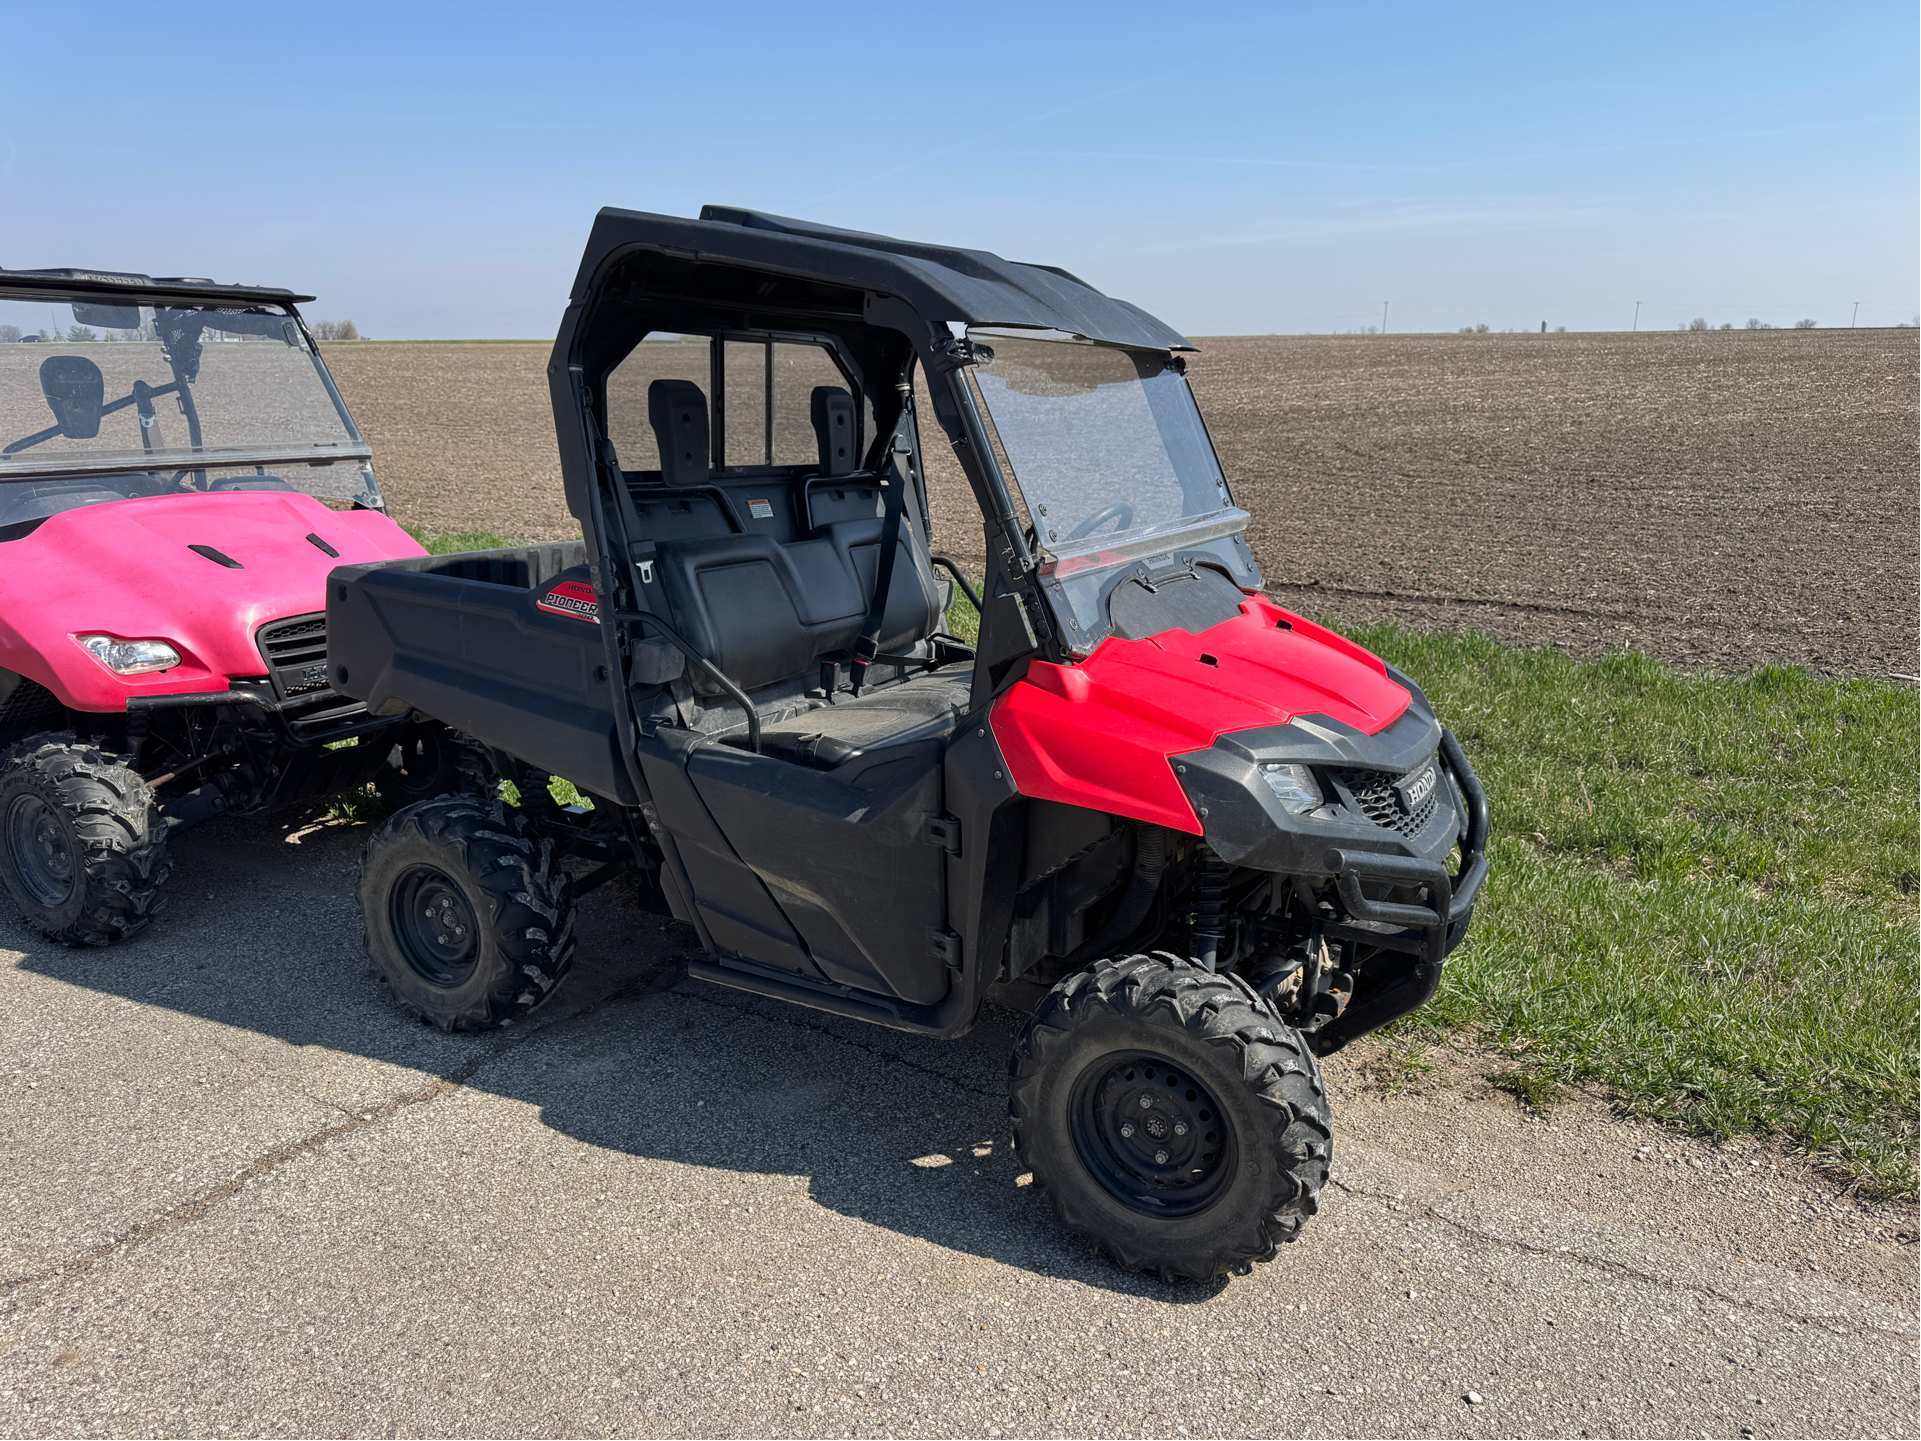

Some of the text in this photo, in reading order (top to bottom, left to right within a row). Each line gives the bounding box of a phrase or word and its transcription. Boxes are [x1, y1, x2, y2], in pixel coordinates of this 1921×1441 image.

[1147, 553, 1170, 565] HONDA
[567, 584, 594, 595] HOND
[545, 593, 598, 614] PIONEER
[1406, 766, 1437, 806] HOND
